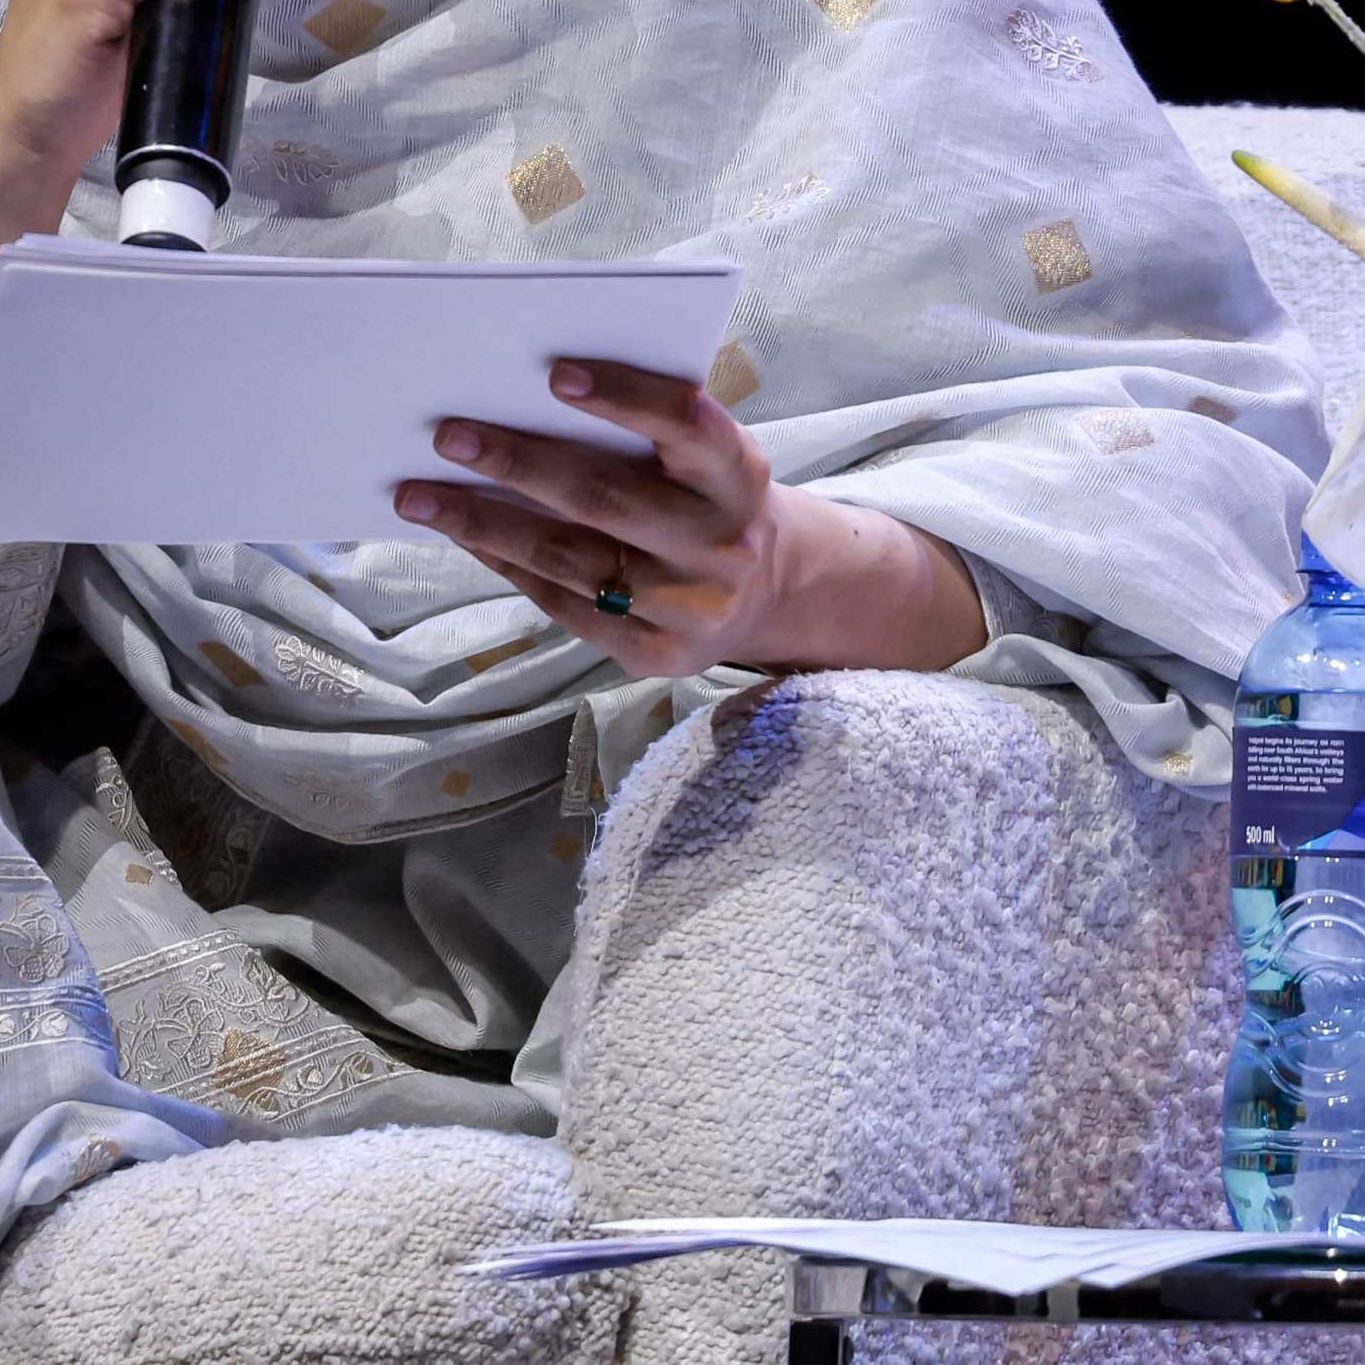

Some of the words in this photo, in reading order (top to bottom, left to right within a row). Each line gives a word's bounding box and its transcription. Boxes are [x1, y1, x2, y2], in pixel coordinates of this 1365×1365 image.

[1294, 738, 1318, 747] journey
[1303, 757, 1330, 765] through
[1324, 767, 1344, 776] bring
[1299, 776, 1320, 784] spring
[1246, 825, 1262, 844] 500
[1263, 825, 1275, 844] ml
